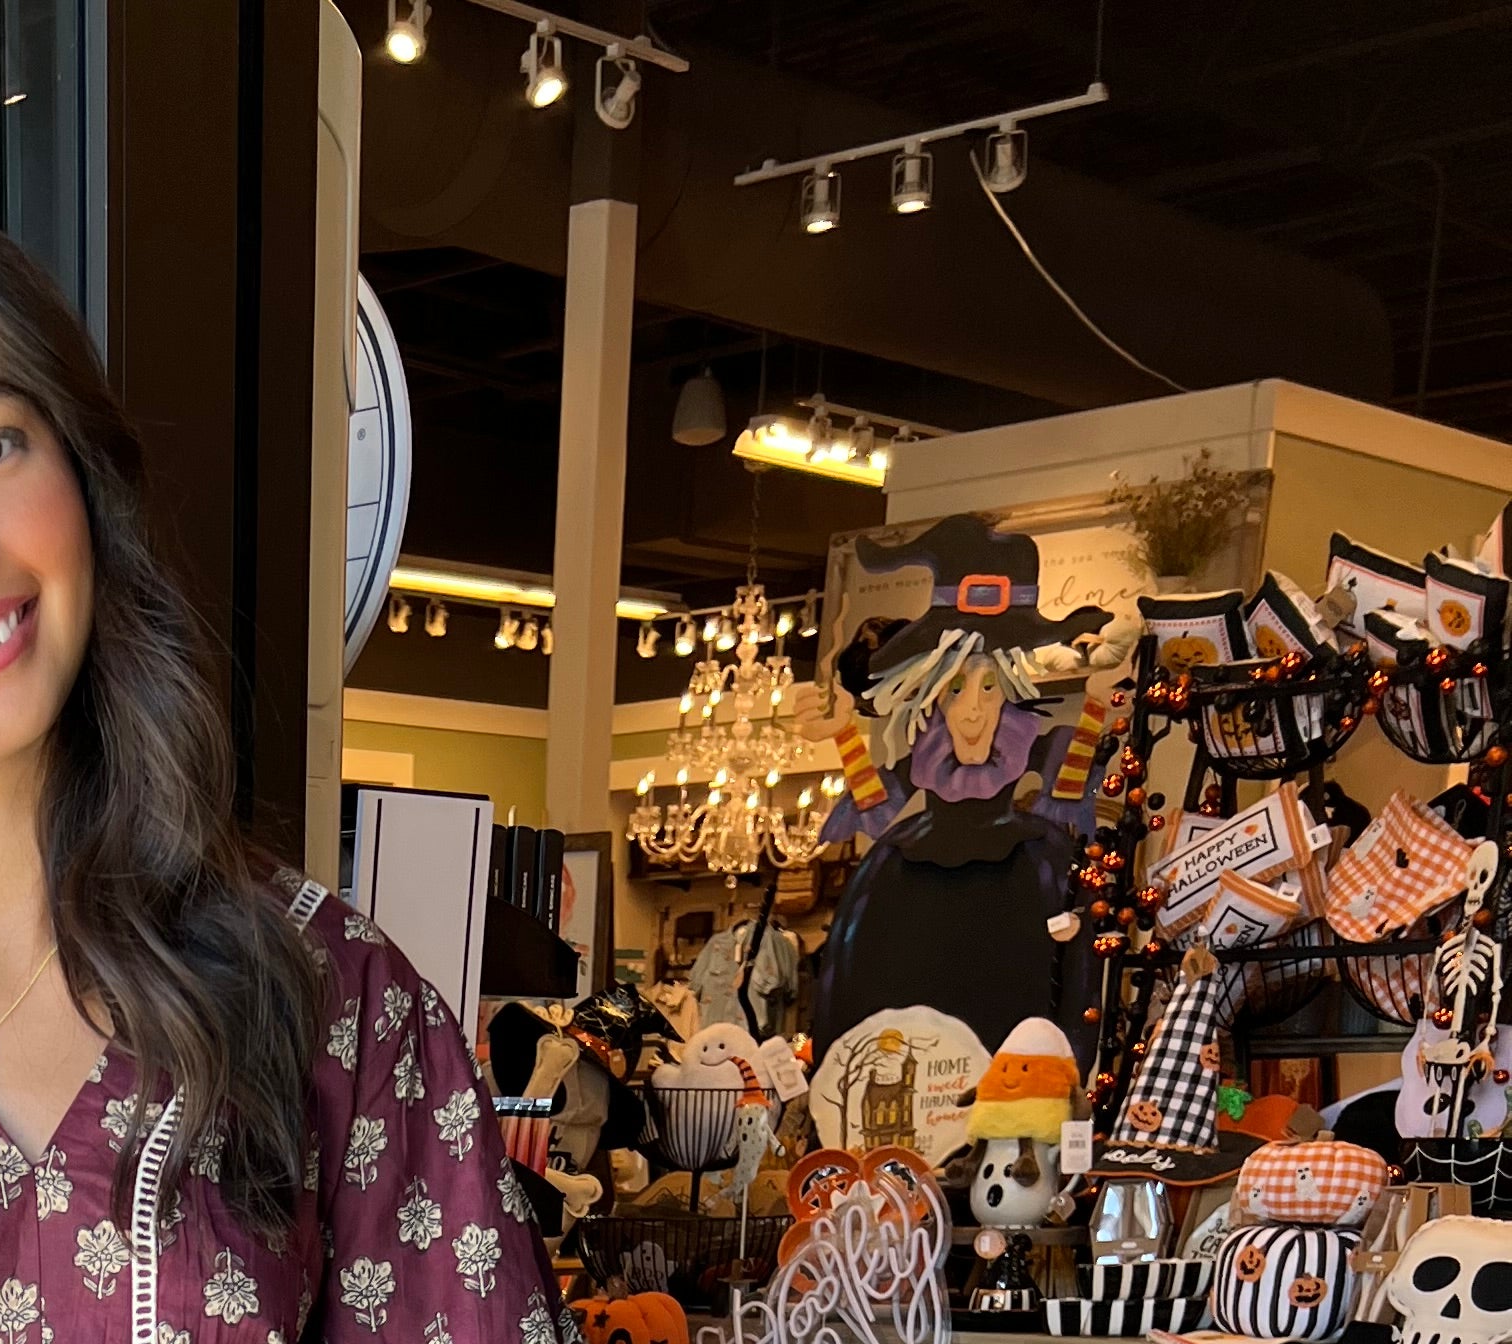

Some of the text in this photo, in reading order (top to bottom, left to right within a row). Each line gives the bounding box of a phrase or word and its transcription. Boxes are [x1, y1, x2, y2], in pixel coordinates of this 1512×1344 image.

[1167, 833, 1269, 898] HALLOWEEN
[1184, 831, 1238, 872] HAPPY
[927, 1056, 971, 1077] HOME
